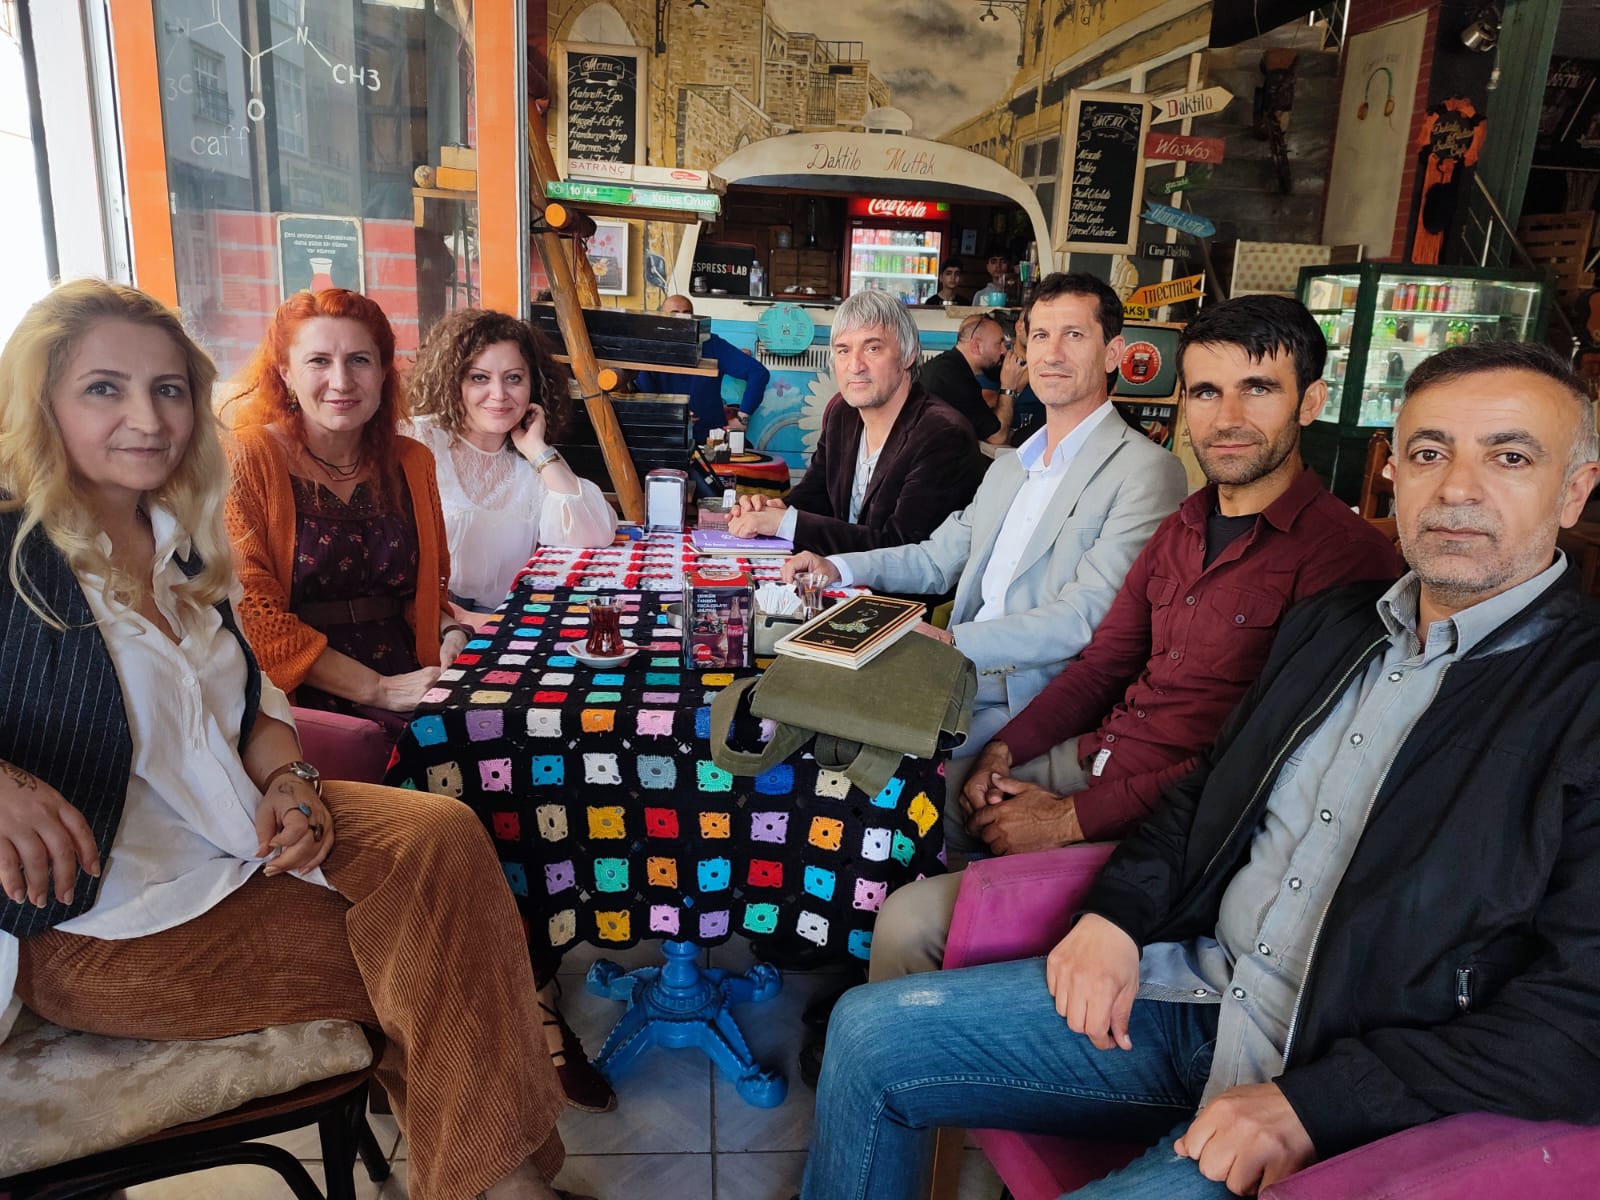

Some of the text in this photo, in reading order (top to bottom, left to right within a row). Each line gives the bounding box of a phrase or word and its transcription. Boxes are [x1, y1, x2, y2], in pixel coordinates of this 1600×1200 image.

[296, 26, 308, 46] N
[332, 63, 381, 92] CH3
[1166, 93, 1213, 118] Daktilo
[570, 161, 625, 175] SATRANÇ
[806, 143, 937, 175] Daktilo Mutfak
[1143, 279, 1193, 305] mecmua
